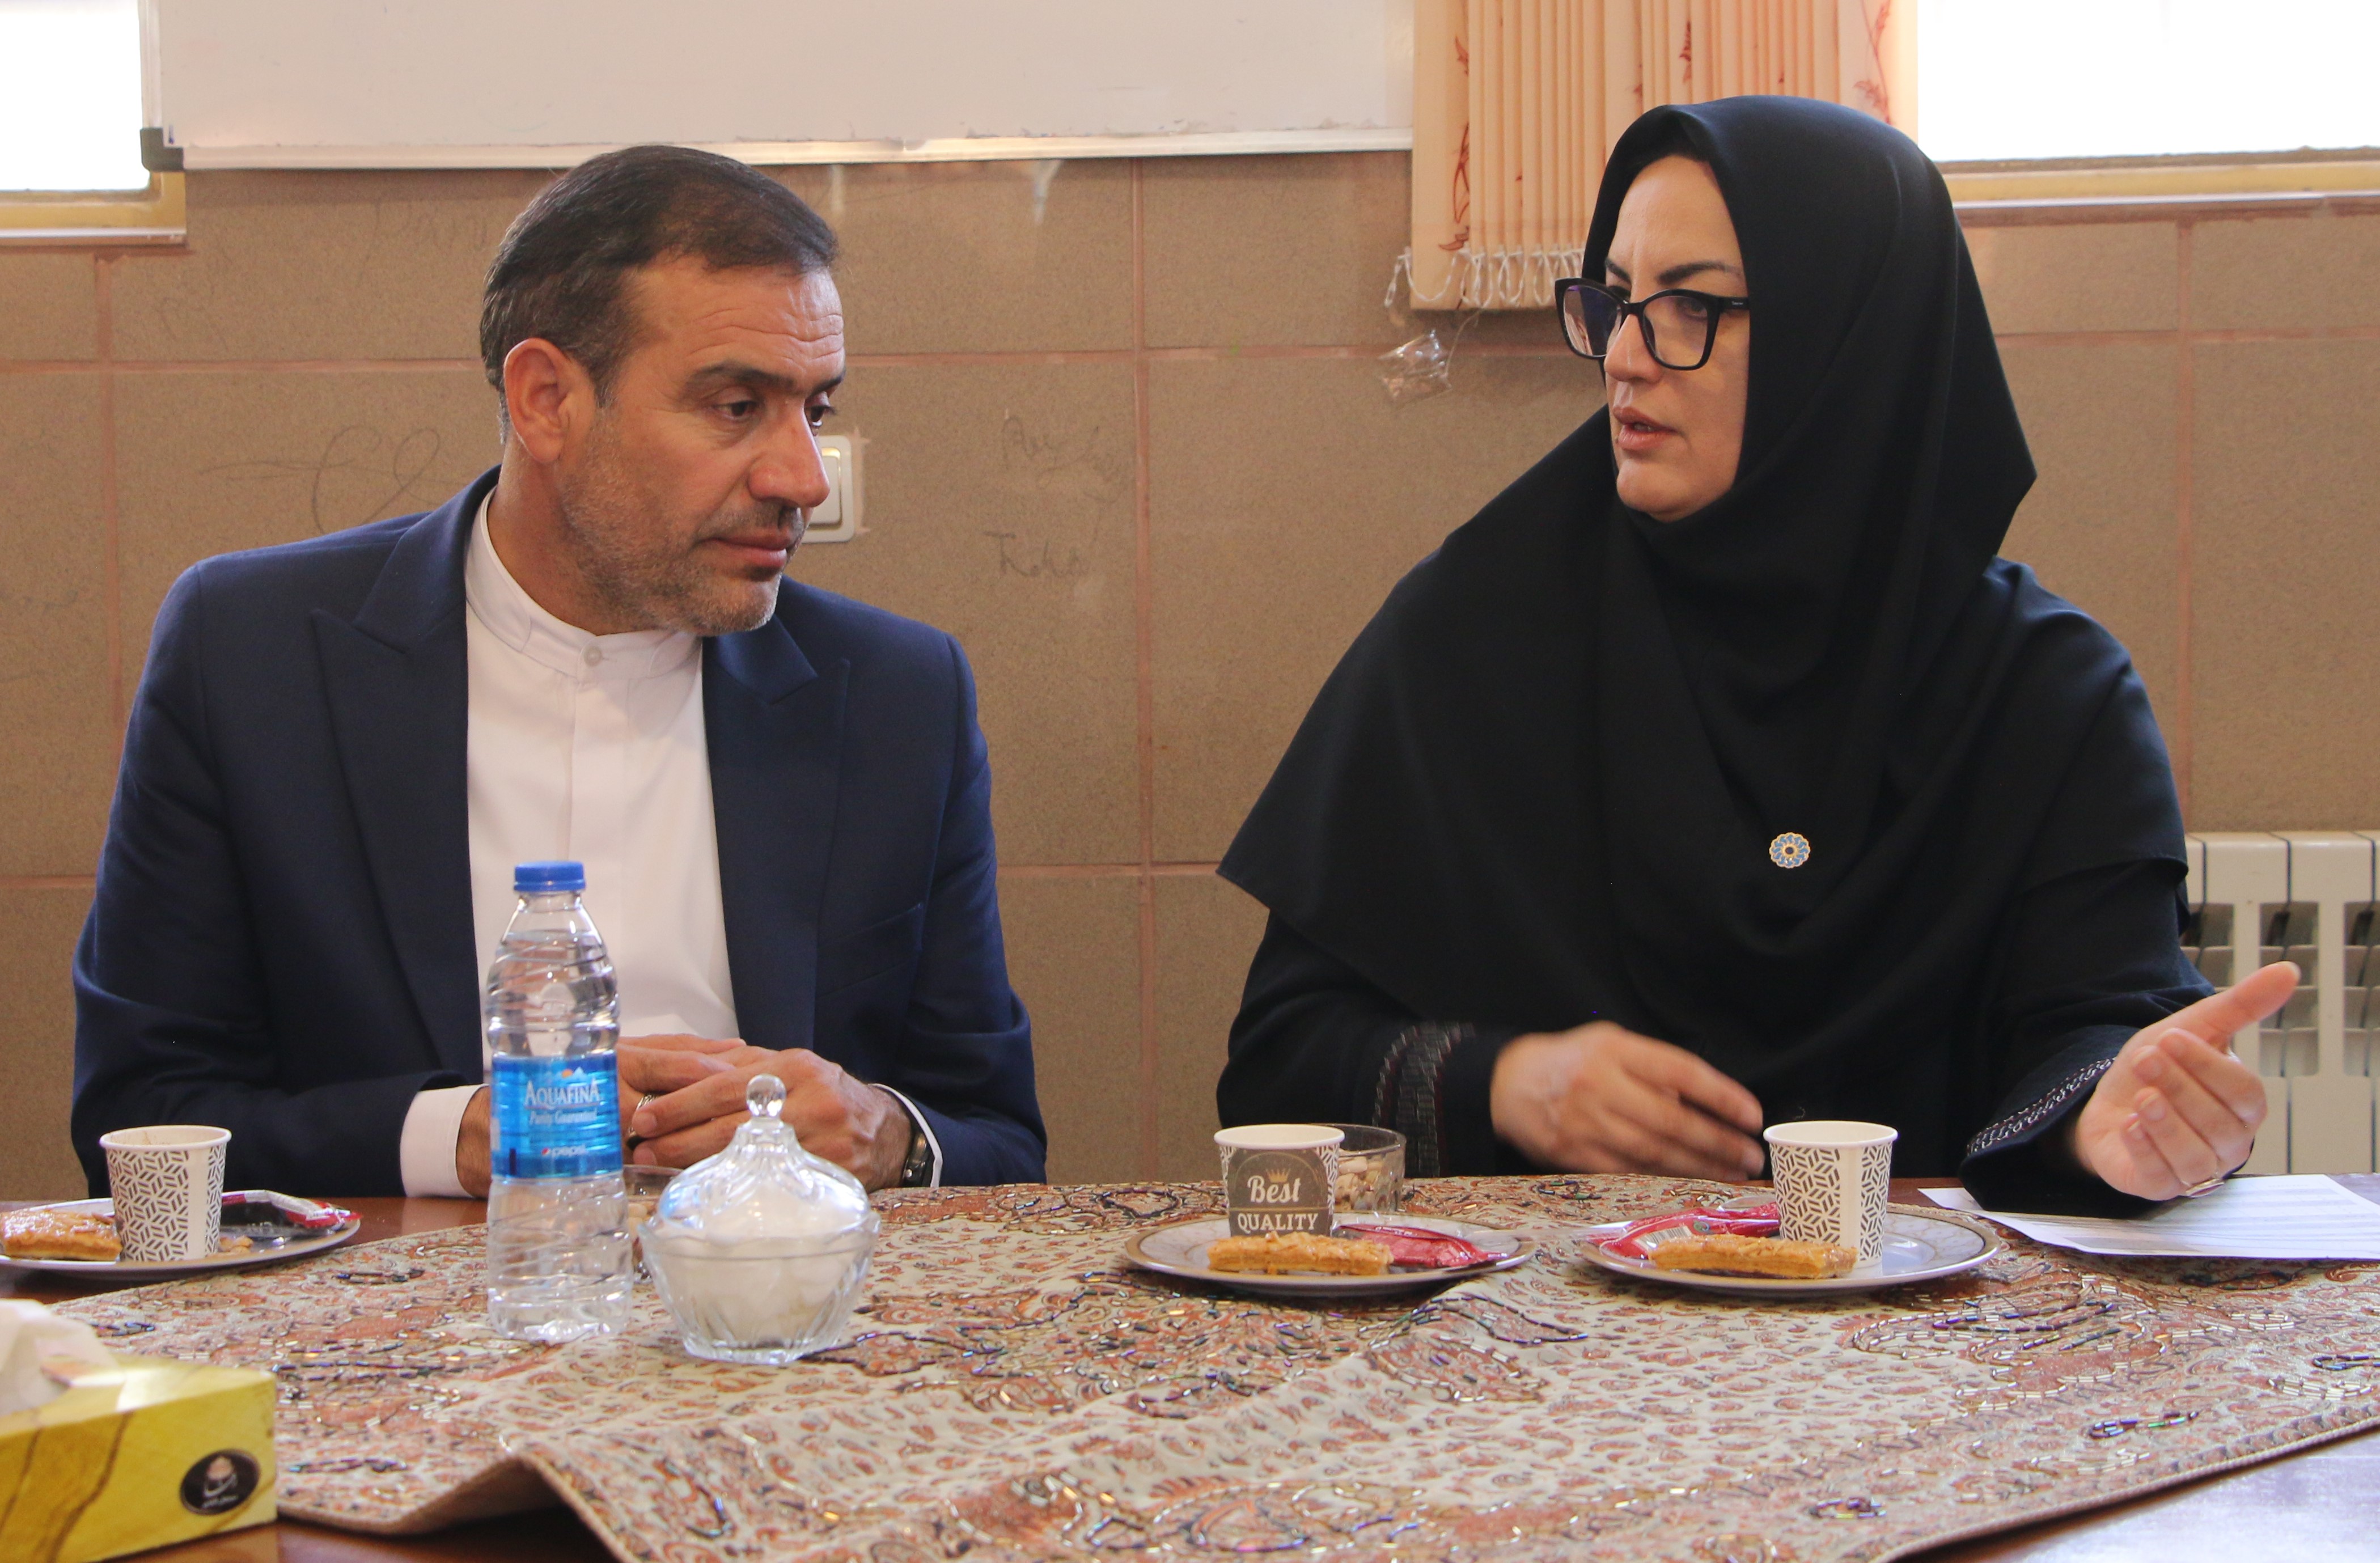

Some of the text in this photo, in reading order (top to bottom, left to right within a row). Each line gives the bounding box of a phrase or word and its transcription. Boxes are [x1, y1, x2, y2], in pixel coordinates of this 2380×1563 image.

[524, 1078, 601, 1110] AQUAFINA
[1247, 1175, 1301, 1204] Best
[1238, 1212, 1319, 1234] QUALITY
